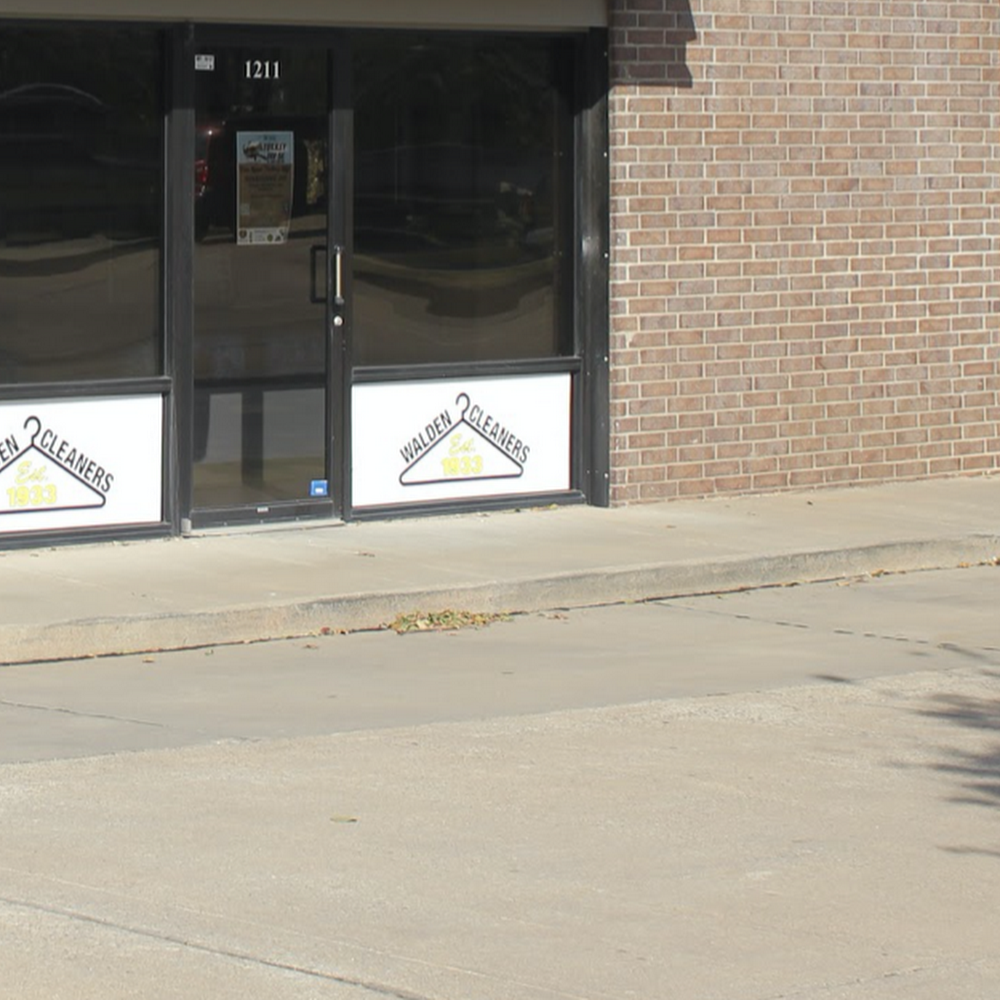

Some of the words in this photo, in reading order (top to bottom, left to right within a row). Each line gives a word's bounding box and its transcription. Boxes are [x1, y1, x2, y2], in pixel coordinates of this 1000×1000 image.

[245, 60, 280, 79] 1211
[399, 409, 453, 464] WALDEN
[468, 404, 531, 464] CLEANERS
[40, 428, 114, 493] CLEANERS
[441, 455, 484, 476] 1933
[6, 483, 58, 508] 1933
